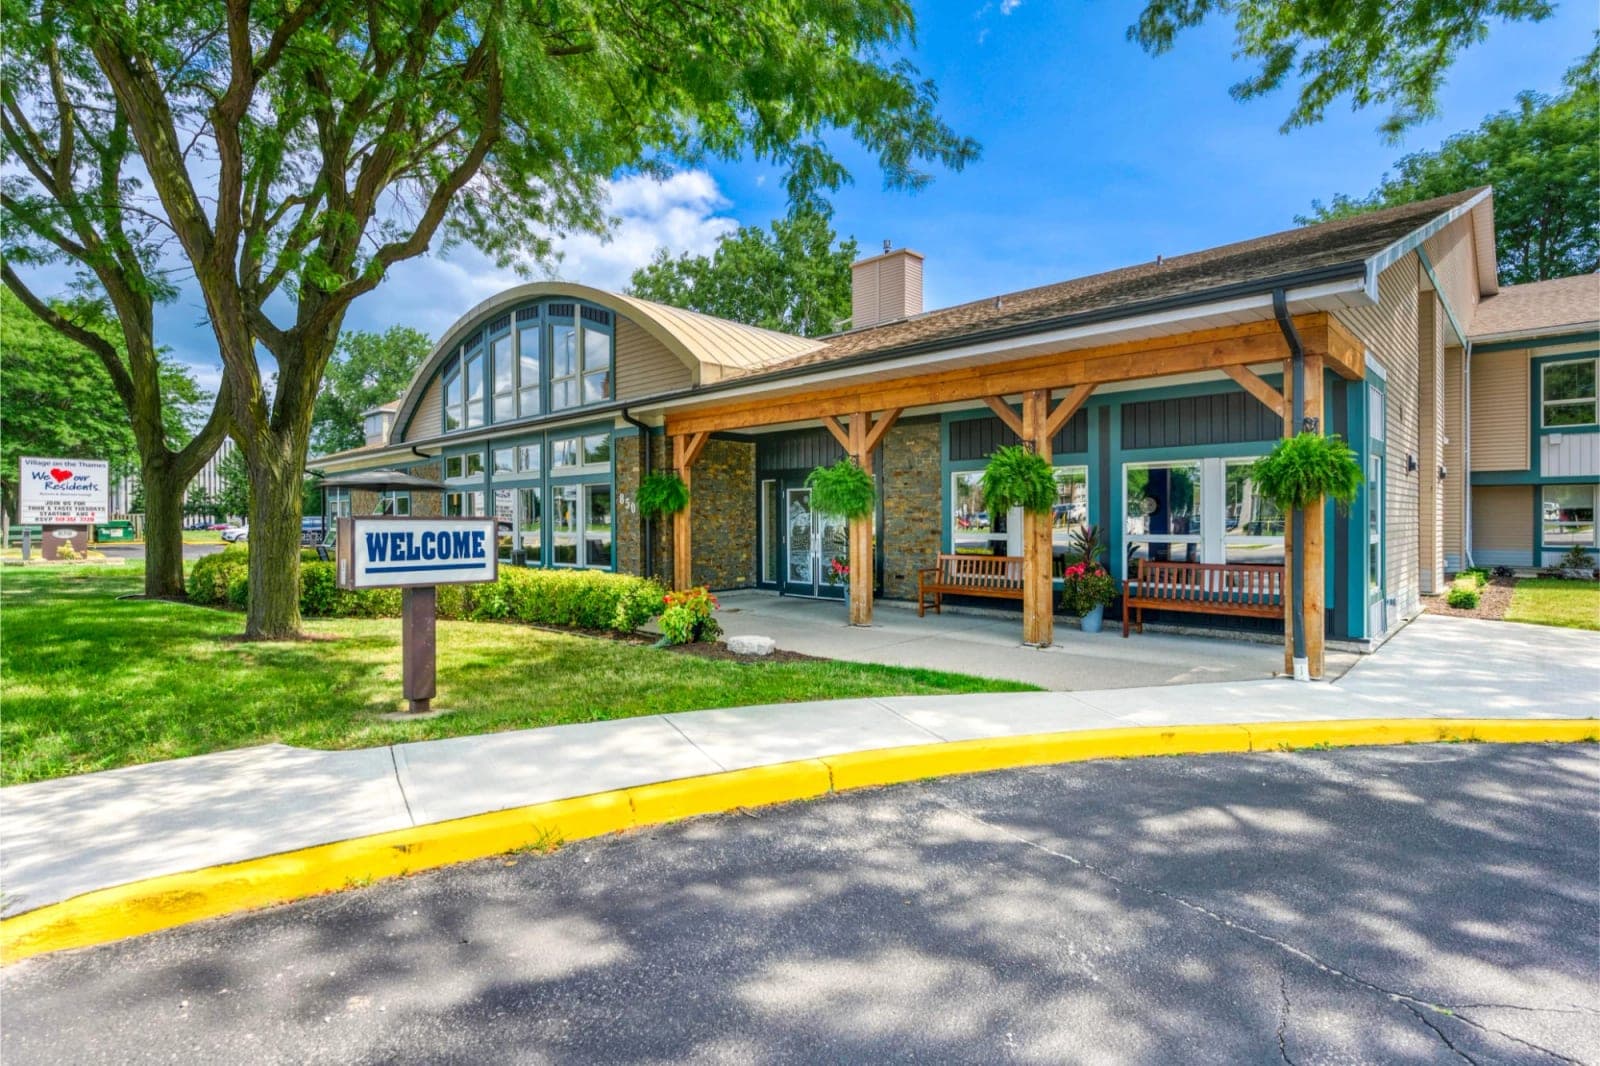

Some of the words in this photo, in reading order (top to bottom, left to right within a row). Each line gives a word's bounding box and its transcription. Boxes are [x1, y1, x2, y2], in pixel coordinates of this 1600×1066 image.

[25, 459, 50, 467] Village
[32, 471, 50, 480] We
[619, 493, 636, 514] 850
[366, 531, 485, 562] WELCOME
